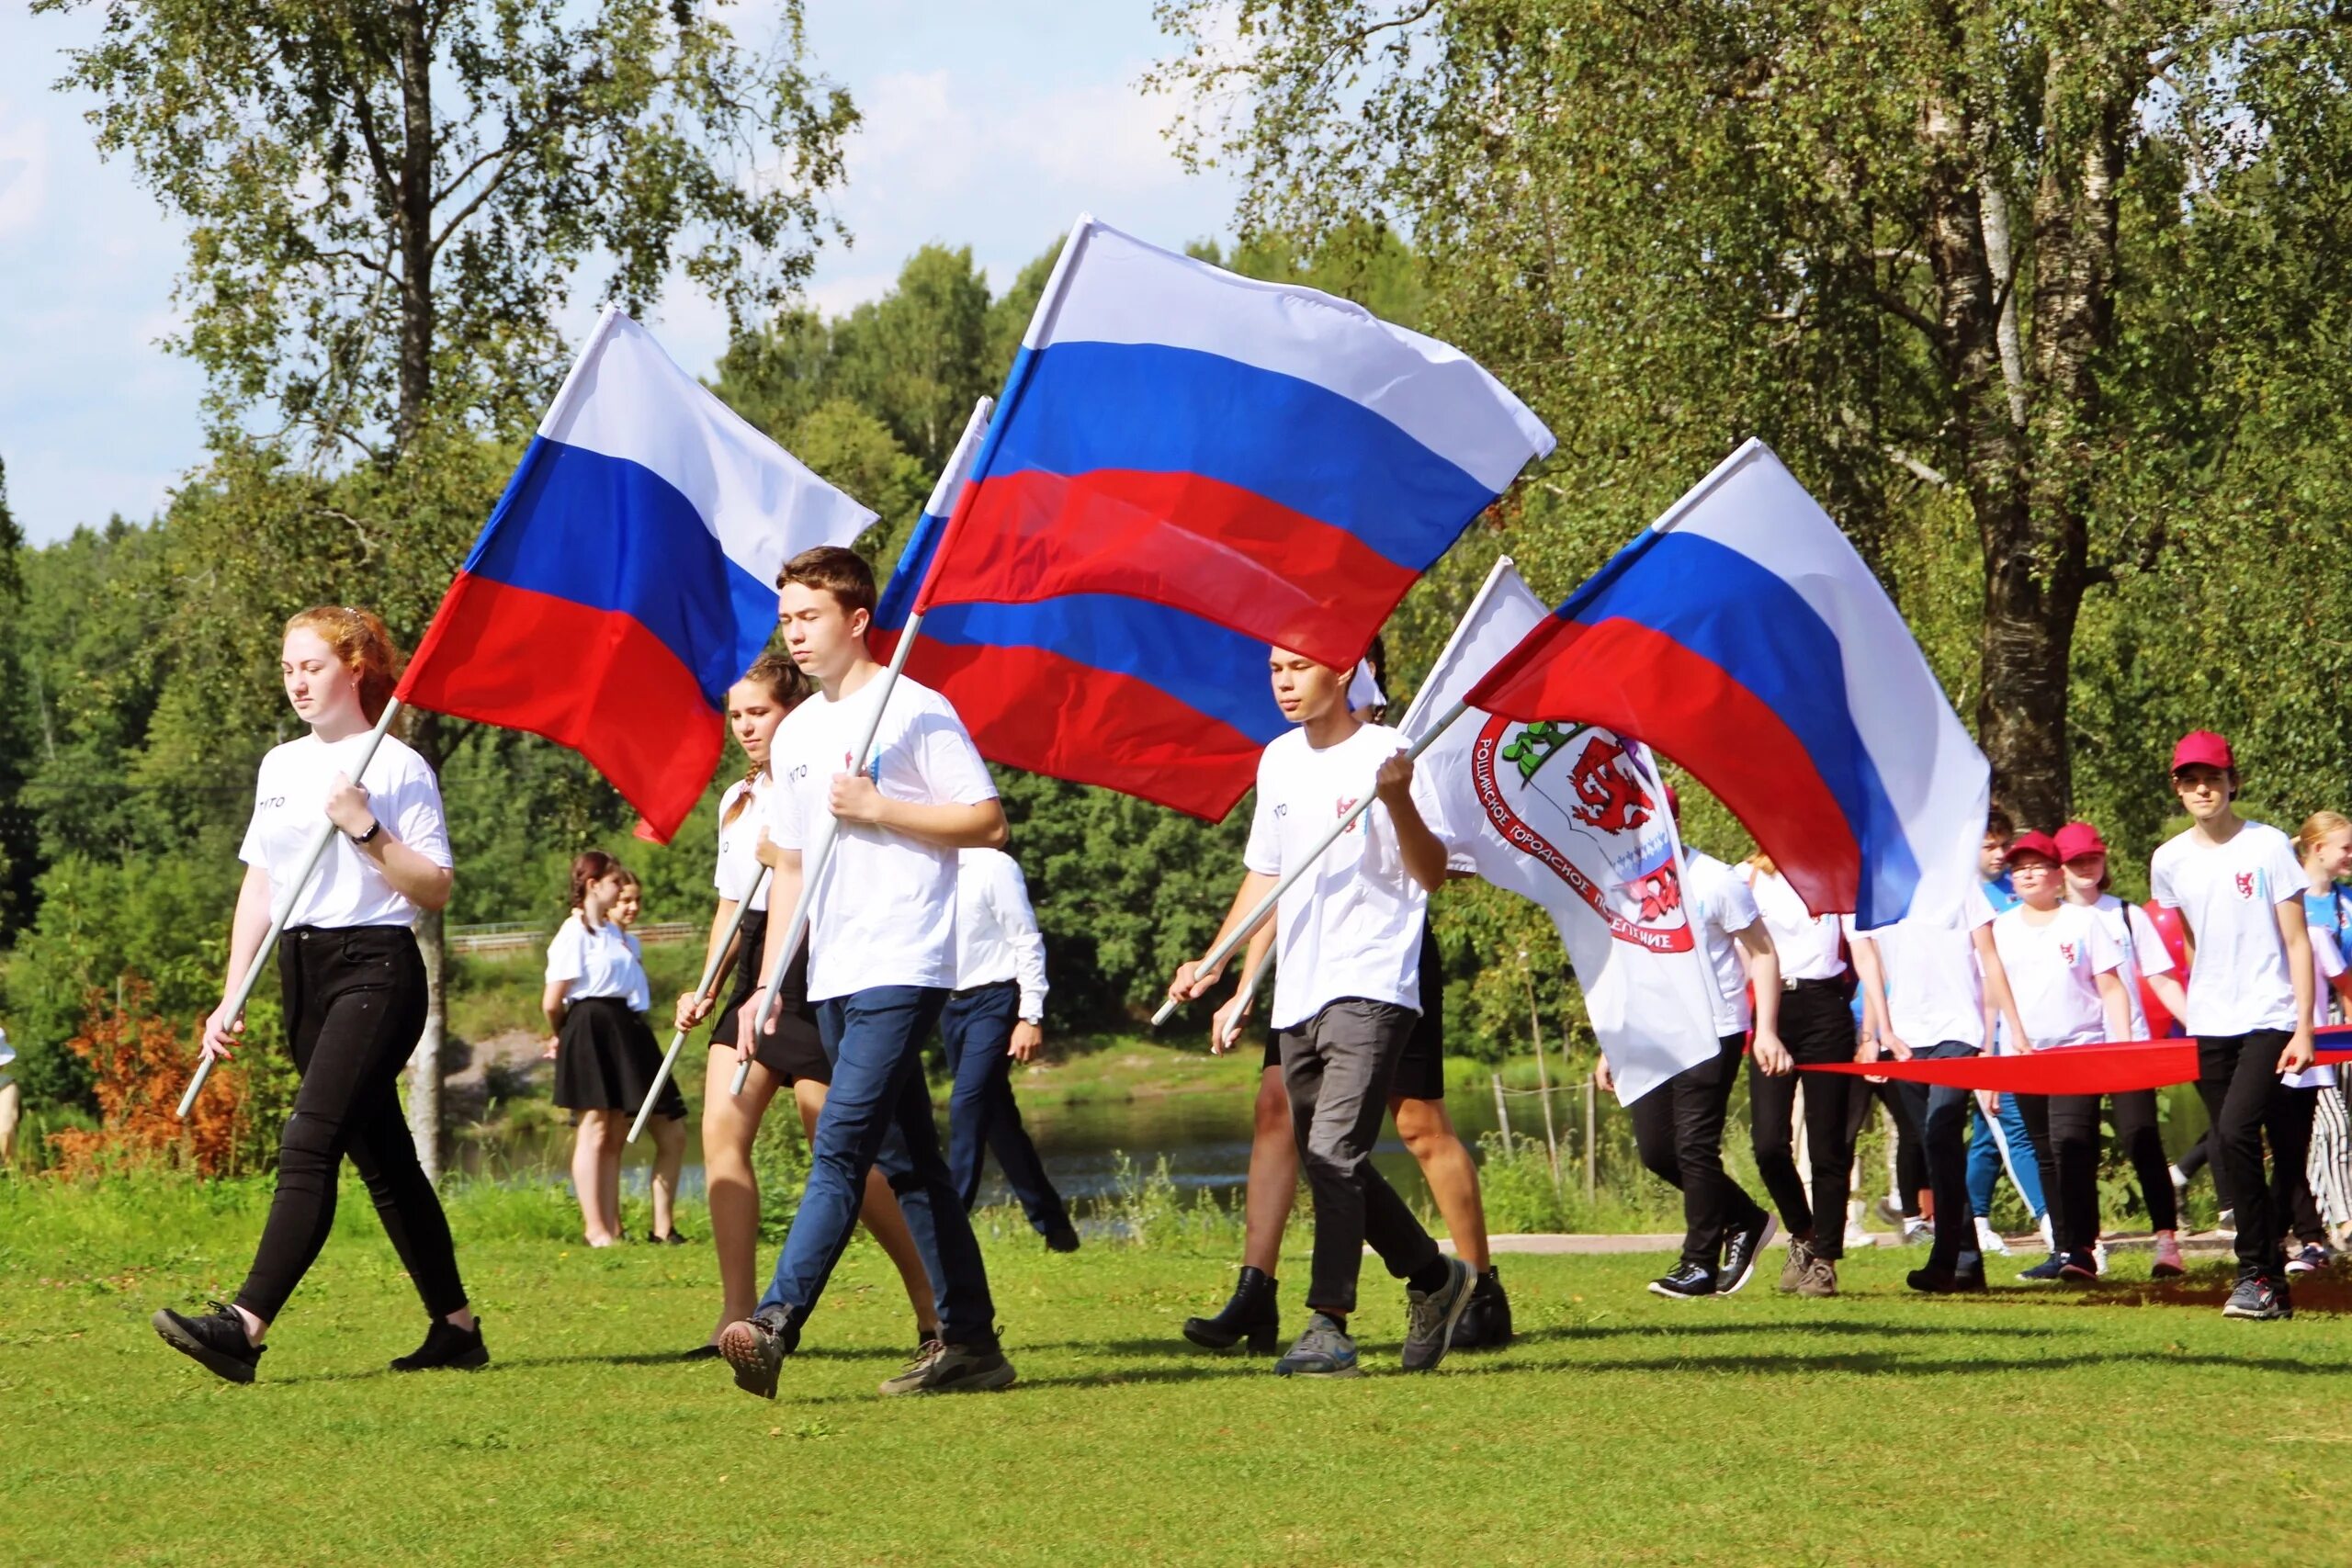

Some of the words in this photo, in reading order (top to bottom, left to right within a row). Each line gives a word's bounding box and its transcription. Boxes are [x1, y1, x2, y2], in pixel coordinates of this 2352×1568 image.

[1476, 738, 1510, 827] РОЩИНСКОЕ
[1510, 825, 1589, 895] ГОРОДСКОЕ
[1594, 893, 1674, 949] ПЕЛЕНИЕ
